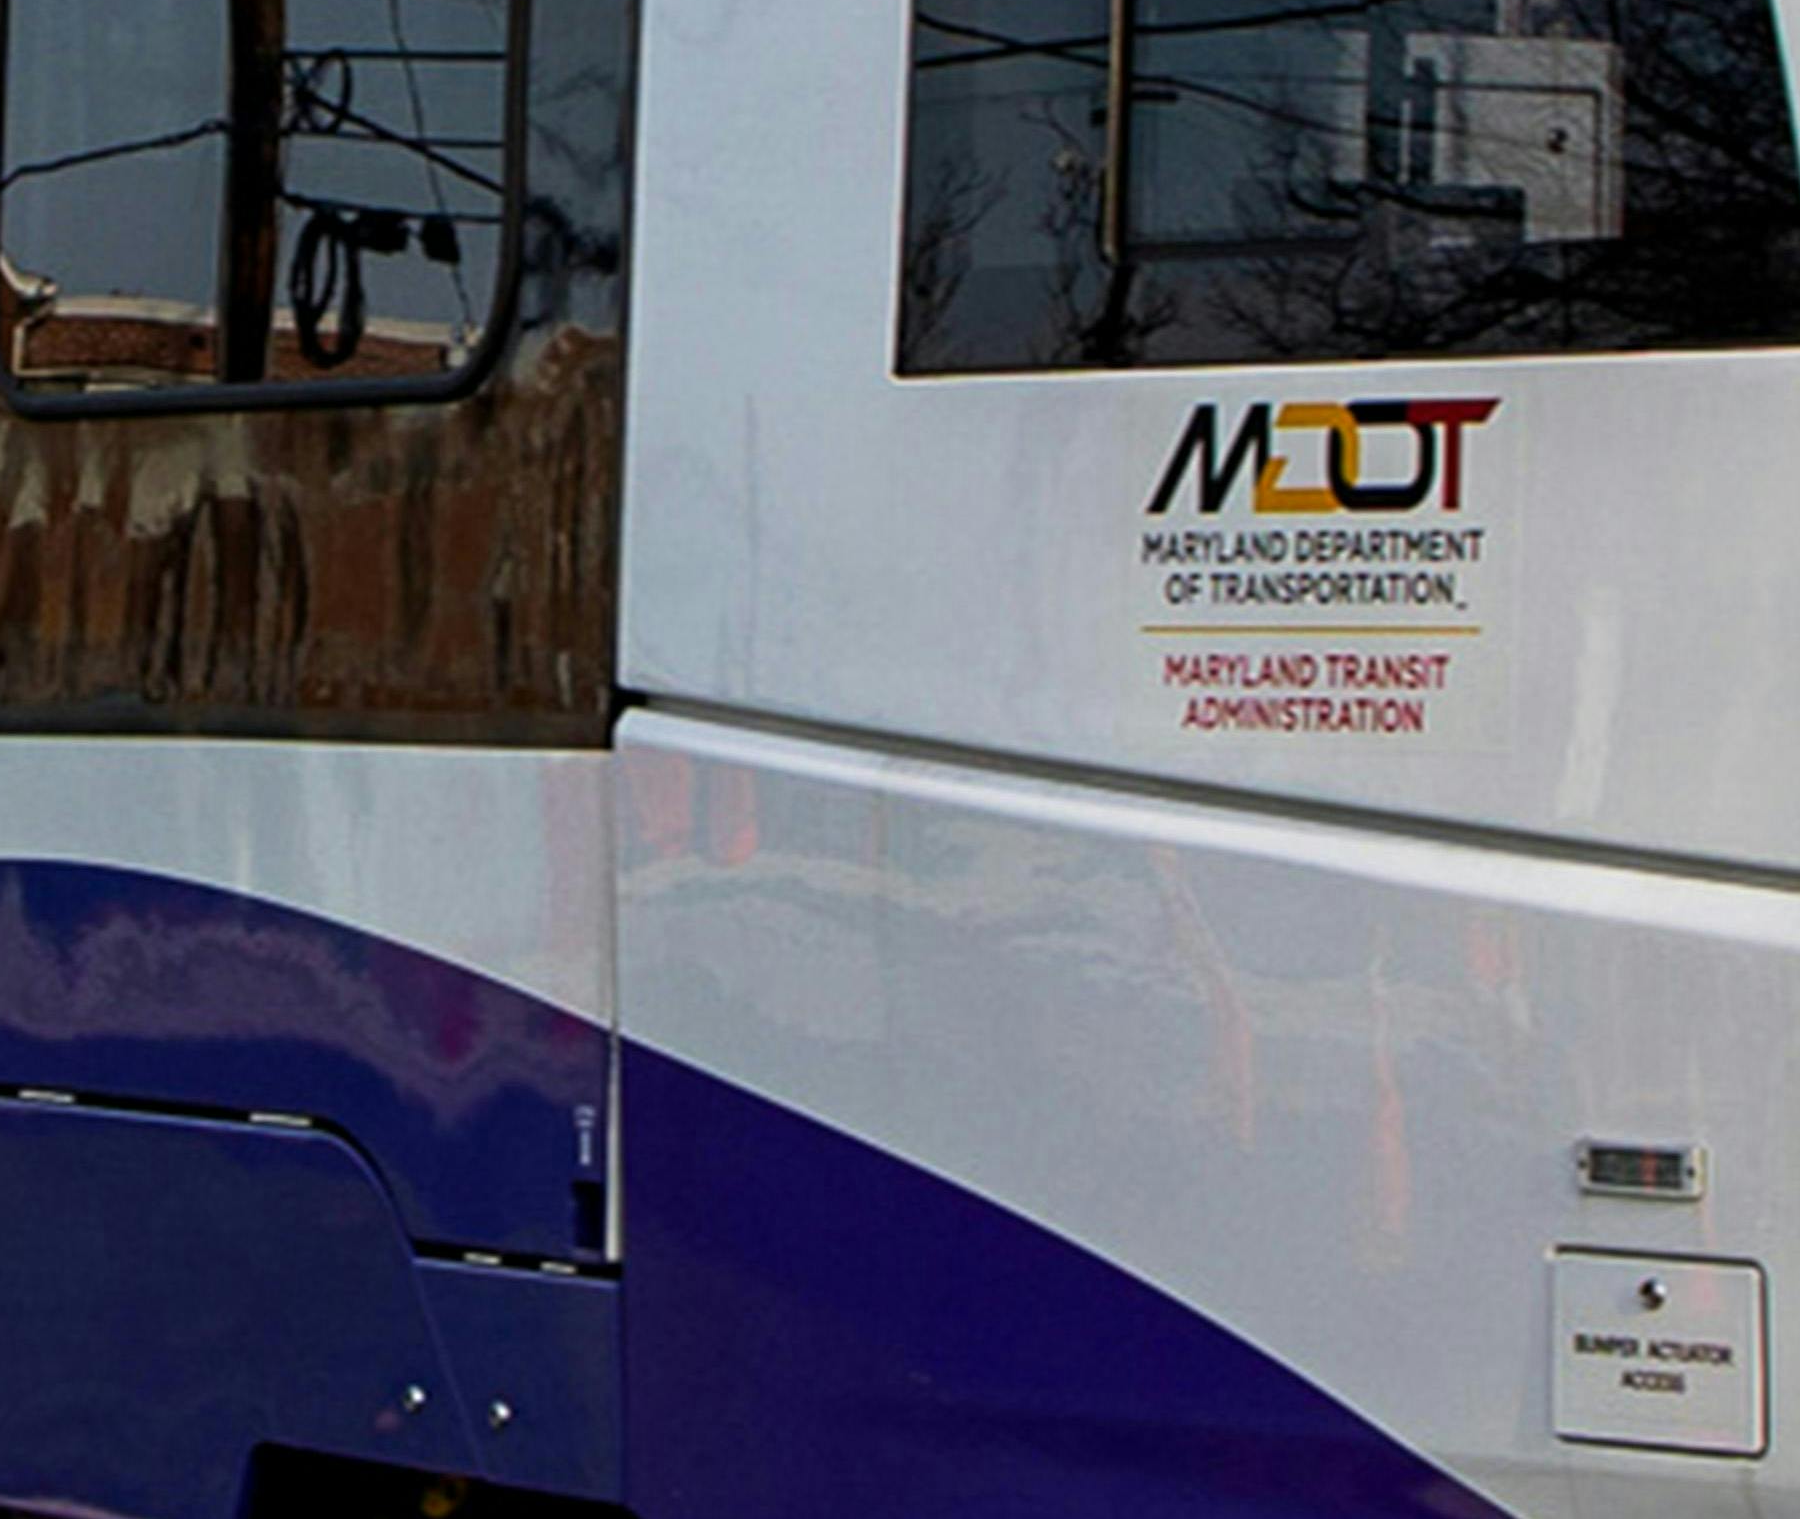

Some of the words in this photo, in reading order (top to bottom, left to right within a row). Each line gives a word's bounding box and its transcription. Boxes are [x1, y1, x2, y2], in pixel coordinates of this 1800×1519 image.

[1145, 398, 1502, 514] MDOT
[1142, 530, 1288, 563] MARYLAND
[1294, 529, 1484, 562] DEPARTMENT
[1164, 572, 1203, 605] OF
[1163, 653, 1317, 689] MARYLAND
[1324, 653, 1450, 689] TRANSIT
[1181, 697, 1424, 733] ADMINISTRATION
